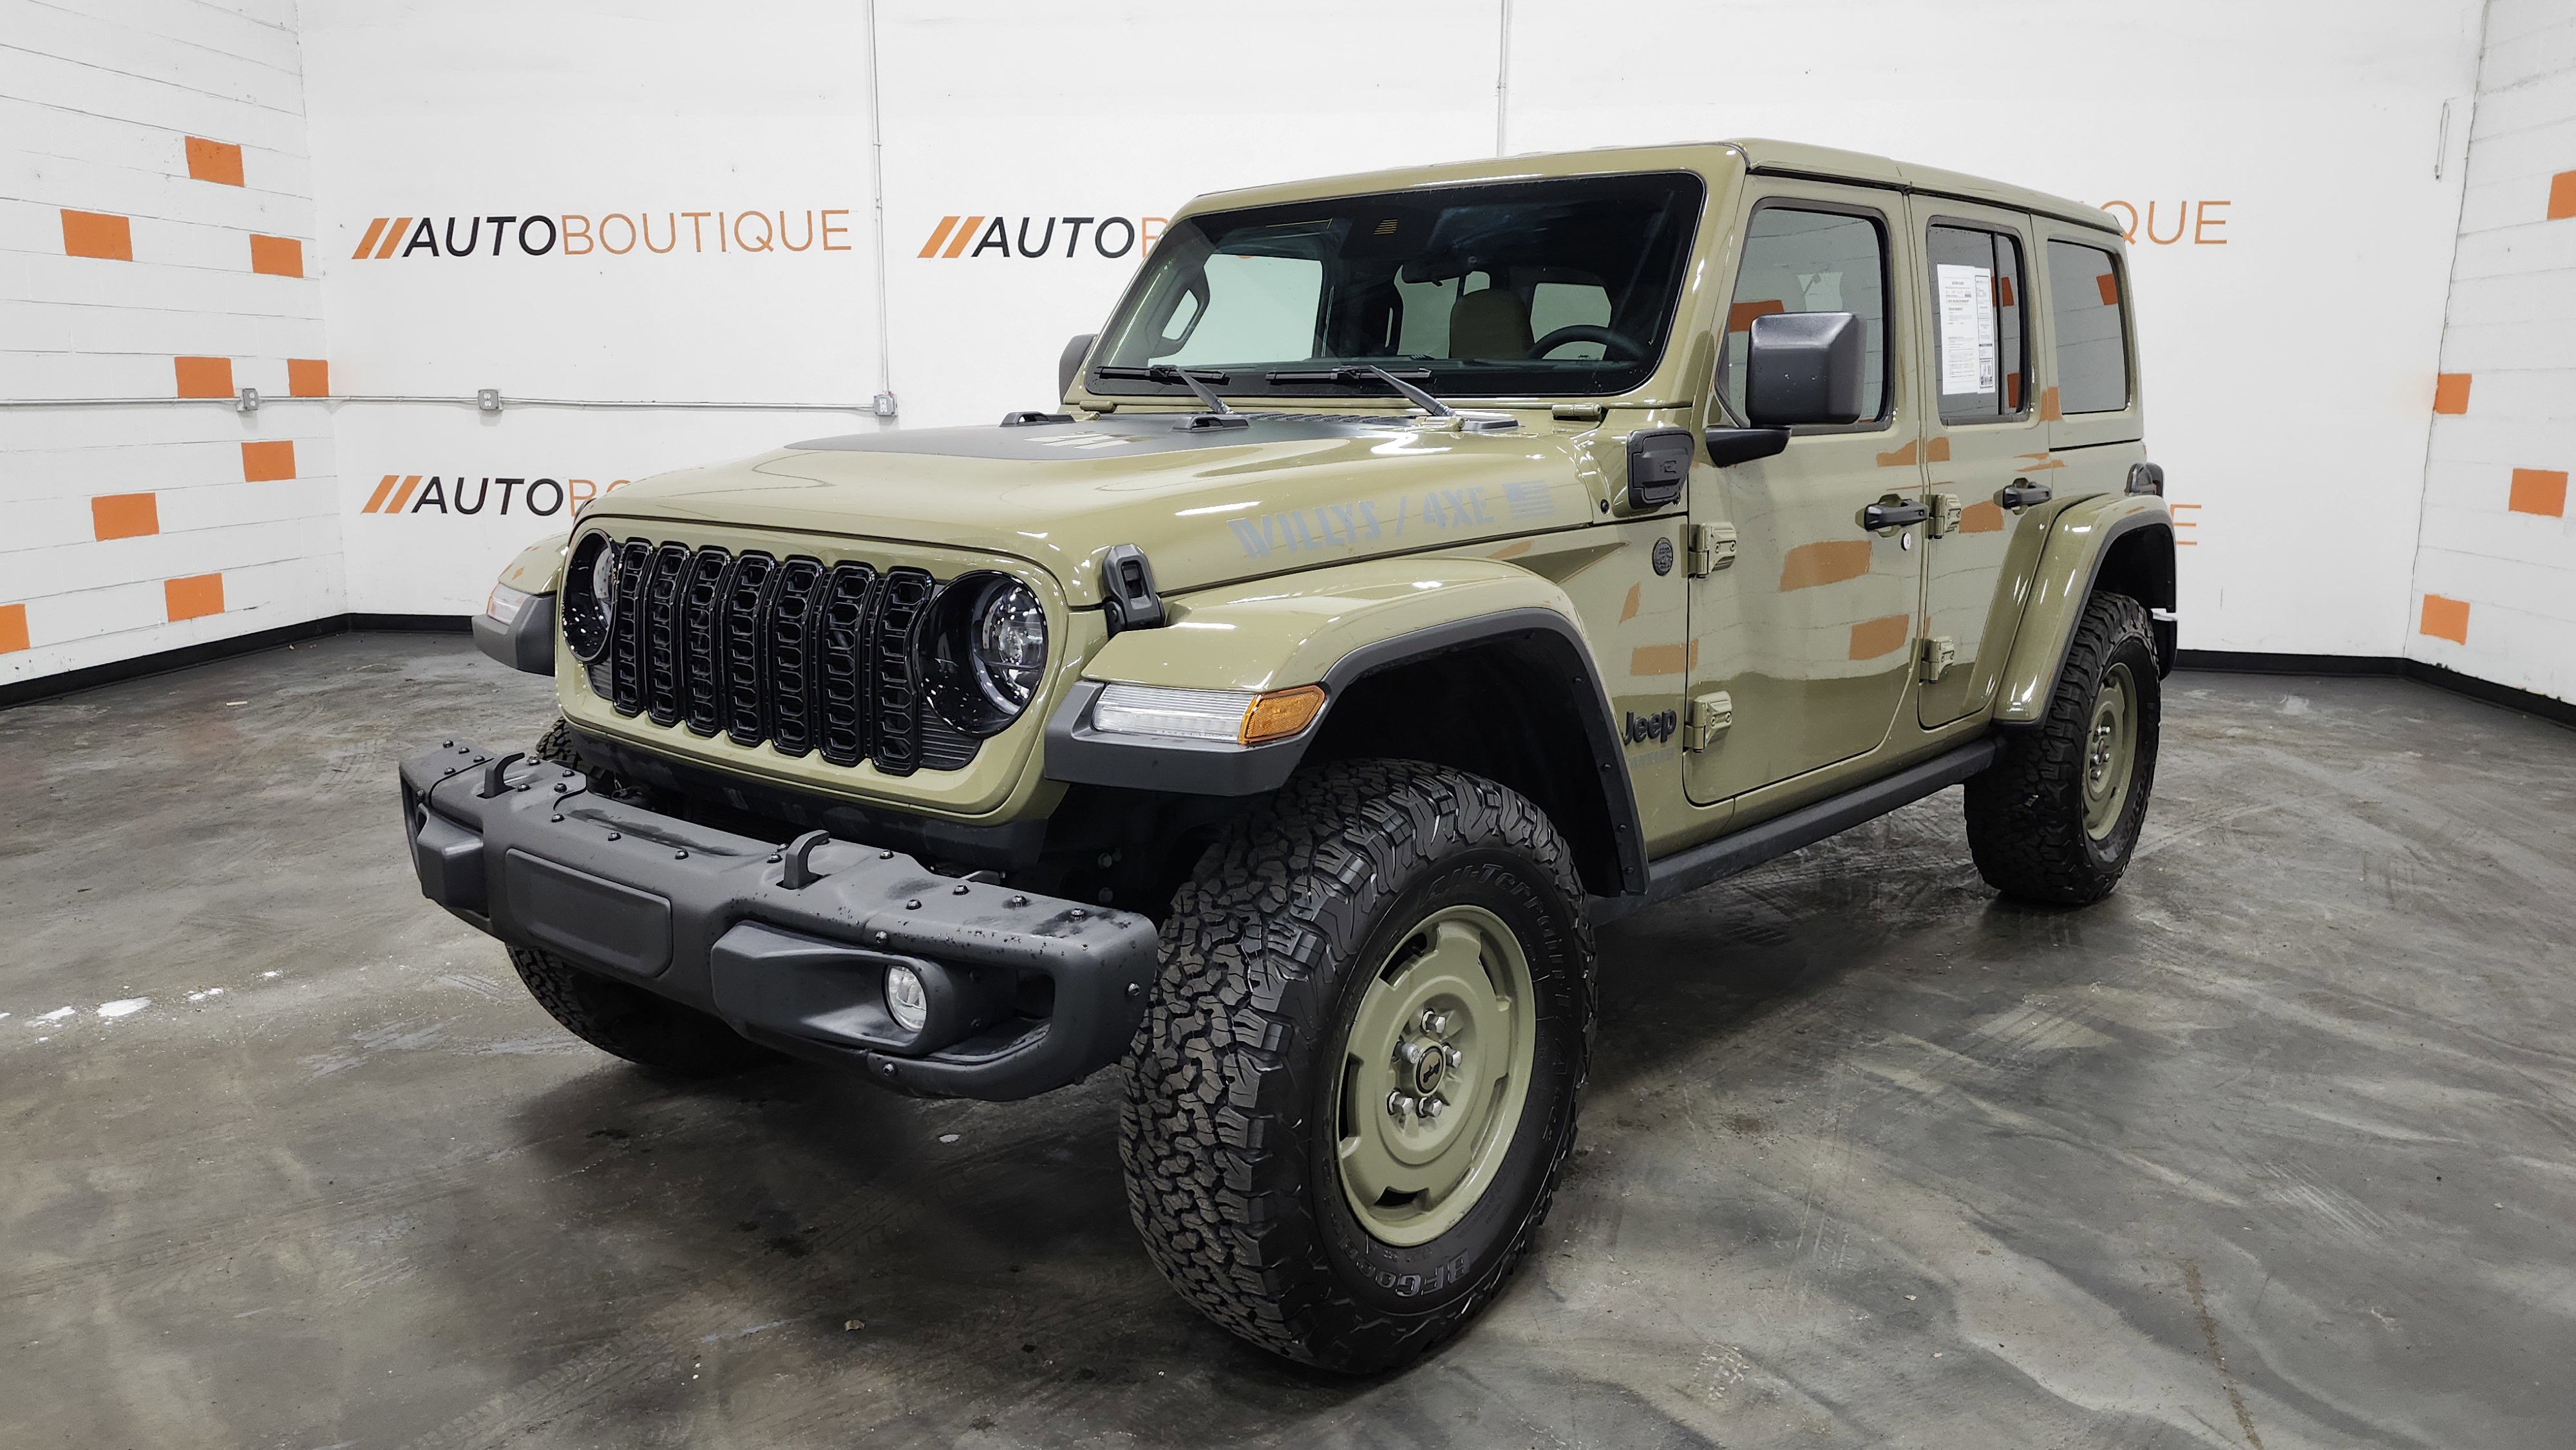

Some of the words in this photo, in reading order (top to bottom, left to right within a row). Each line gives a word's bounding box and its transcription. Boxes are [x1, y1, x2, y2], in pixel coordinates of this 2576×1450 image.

[1226, 500, 1382, 560] WILLYS
[1422, 486, 1495, 530] 4XE
[1621, 708, 1677, 746] Jeep
